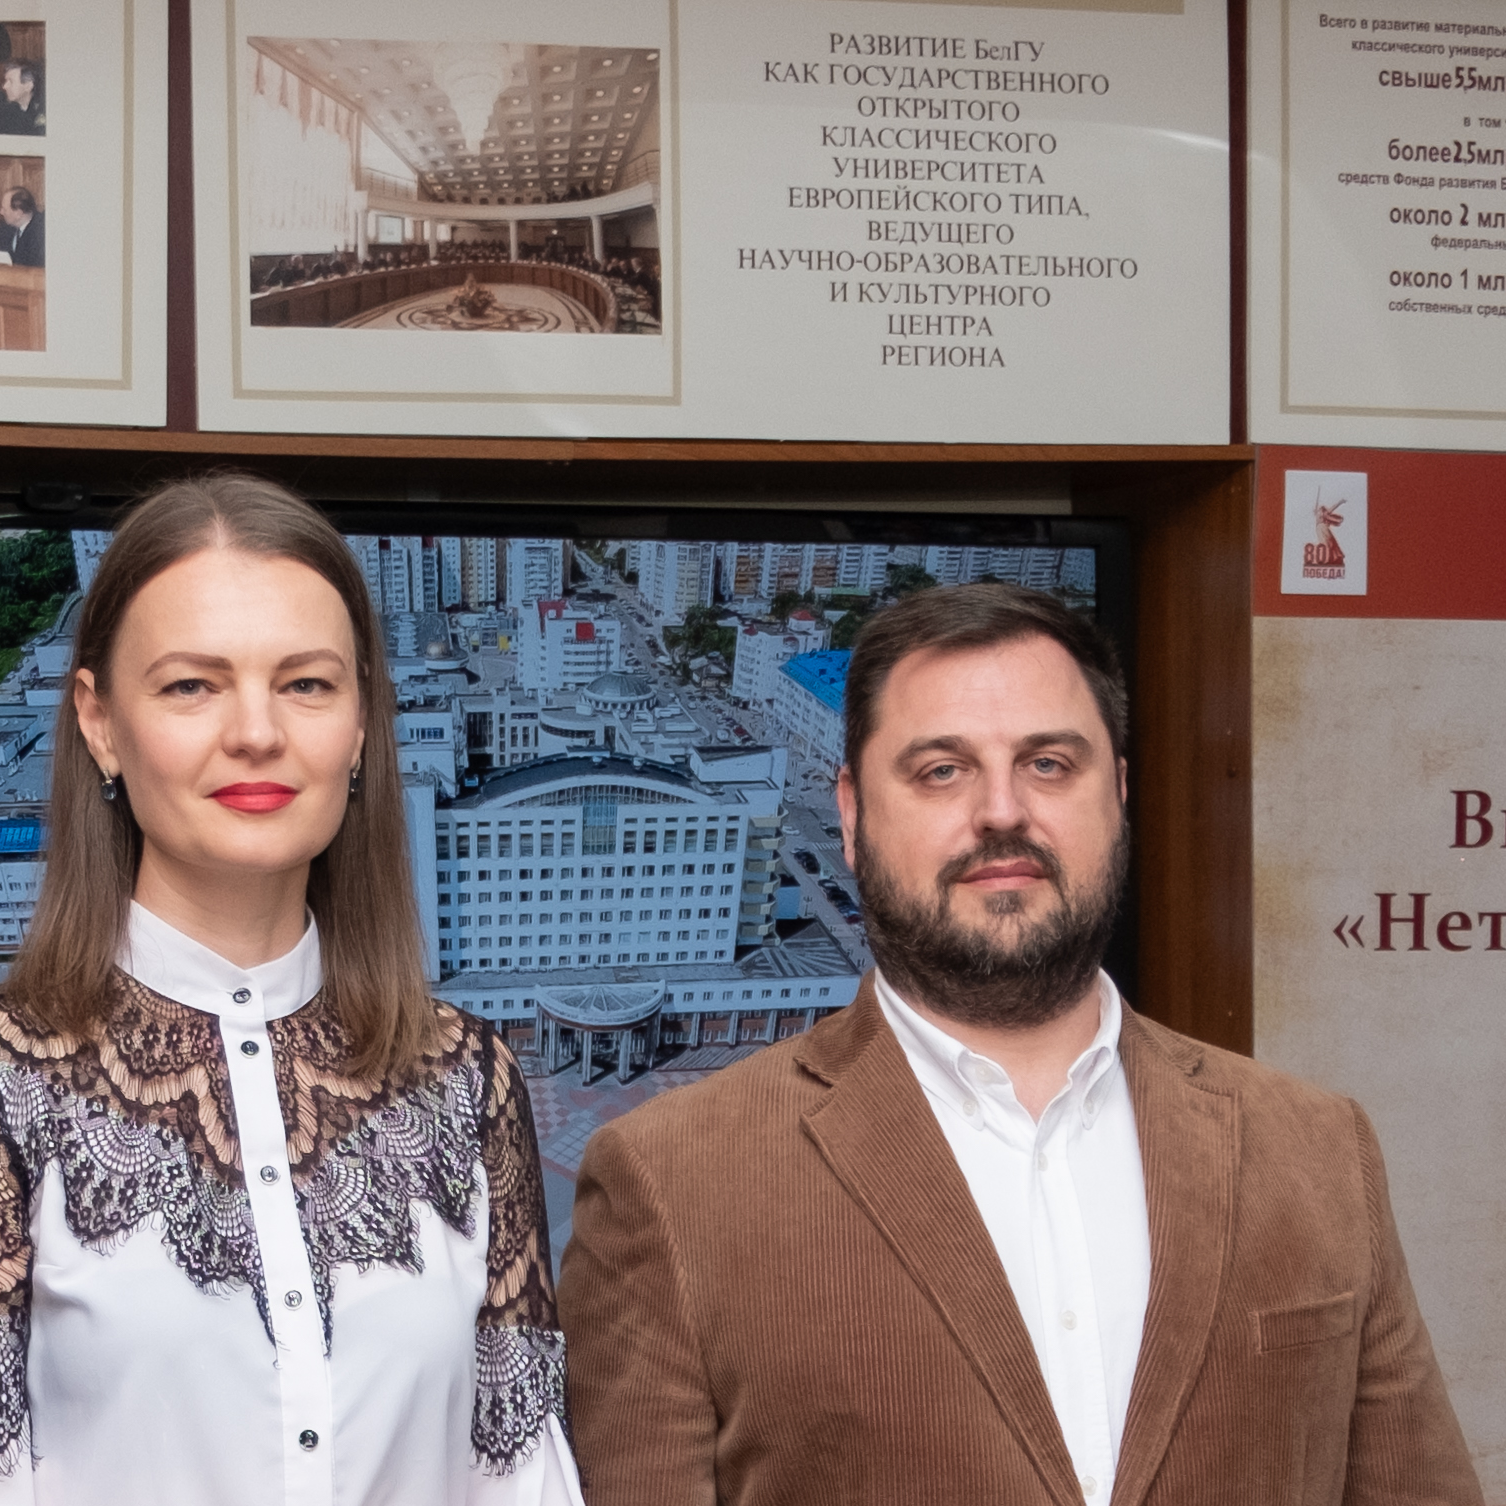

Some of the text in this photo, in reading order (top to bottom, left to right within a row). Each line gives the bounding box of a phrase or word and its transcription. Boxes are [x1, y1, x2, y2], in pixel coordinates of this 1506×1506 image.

[1319, 14, 1357, 30] Всего
[1360, 19, 1368, 29] в
[1372, 19, 1431, 33] развитие
[829, 32, 1045, 62] РАЗВИТИЕ БелГУ
[1351, 40, 1445, 56] классического
[763, 61, 1110, 96] КАК ГОСУДАРСТВЕННОГО
[857, 96, 1020, 123] ОТКРЫТОГО
[1463, 117, 1471, 127] в
[1478, 118, 1502, 128] том
[821, 125, 1058, 155] КЛАССИЧЕСКОГО
[832, 157, 1046, 185] УНИВЕРСИТЕТА
[1338, 172, 1390, 187] средств
[1393, 174, 1435, 189] Фонда
[1438, 177, 1497, 192] развития
[787, 185, 1091, 219] ЕВРОПЕЙСКОГО ТИПА,
[1389, 205, 1452, 227] около
[1460, 203, 1470, 227] 2
[867, 220, 1015, 247] ВЕДУЩЕГО
[738, 248, 1138, 279] НАУЧНО-ОБРАЗОВАТЕЛЬНОГО
[1389, 268, 1452, 290] около
[1460, 268, 1469, 290] 1
[829, 281, 1052, 308] И КУЛЬТУРНОГО
[1388, 299, 1474, 317] собственных
[887, 314, 994, 339] ЦЕНТРА
[881, 344, 1007, 369] РЕГИОНА
[1304, 543, 1329, 565] 80
[1303, 568, 1345, 580] ПОБЕДА!
